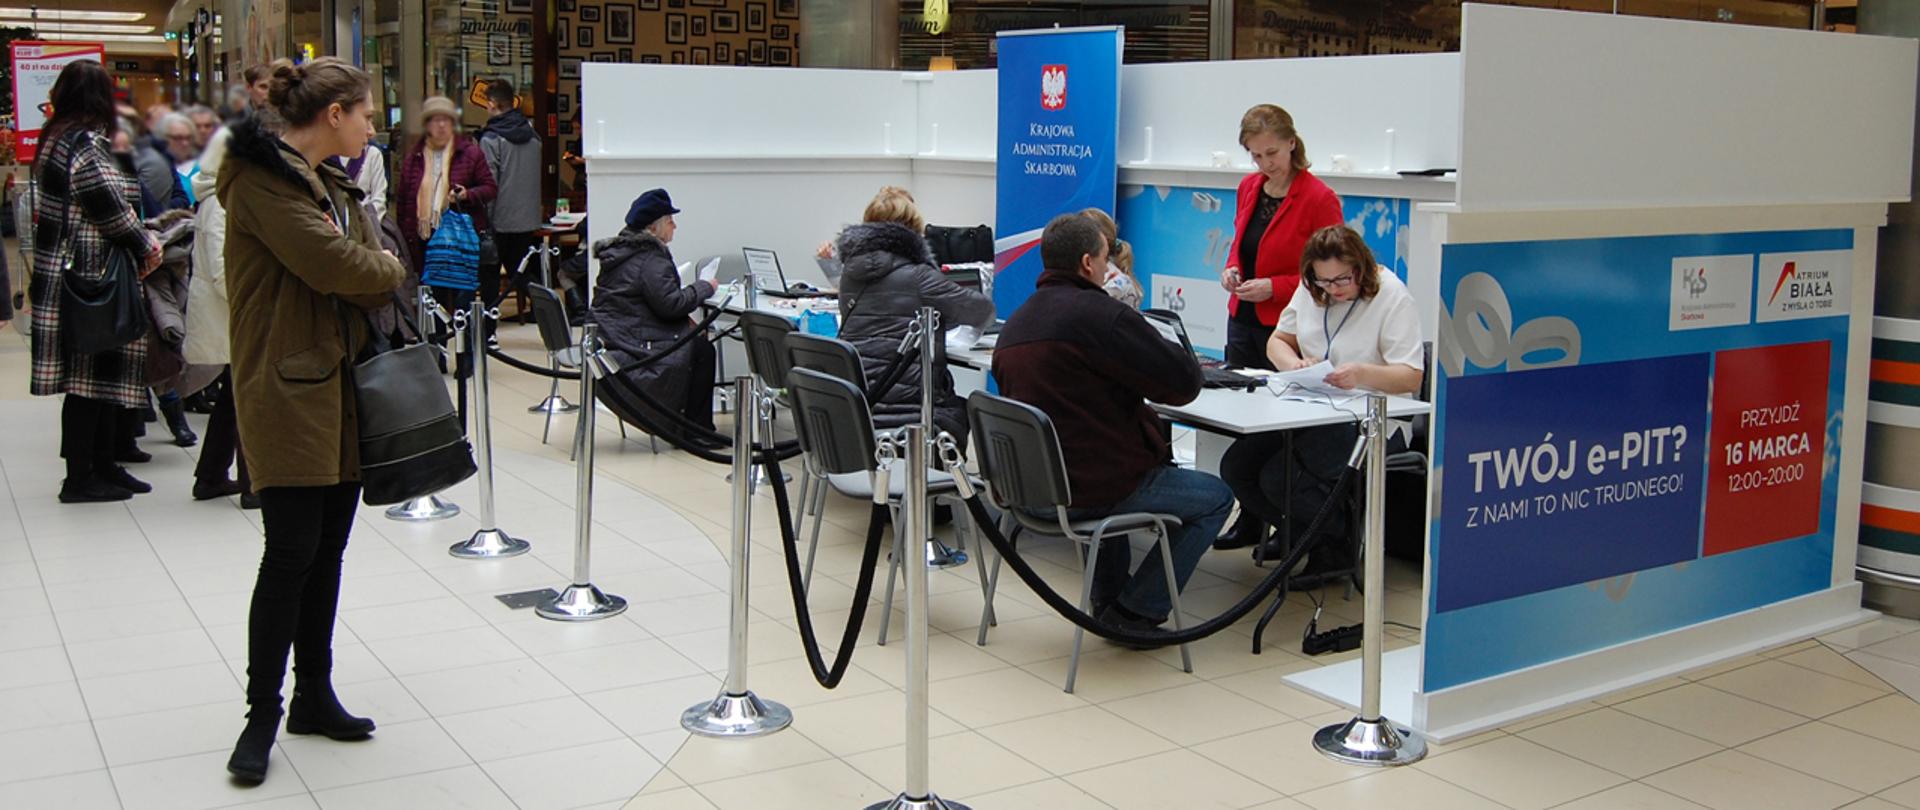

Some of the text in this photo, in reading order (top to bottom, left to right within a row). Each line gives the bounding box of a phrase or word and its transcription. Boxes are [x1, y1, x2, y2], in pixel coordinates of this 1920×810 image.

[1030, 122, 1075, 139] KRAJOWA
[1012, 143, 1093, 158] ADMINISTRACJA
[1024, 161, 1077, 177] SKARBOWA
[1790, 281, 1833, 299] BIAŁA
[1740, 400, 1800, 429] PRZYJDŹ
[1468, 425, 1688, 493] TWÓJ e-PIT?
[1725, 432, 1811, 466] 16 MARCA
[1728, 463, 1804, 493] 12:00-20:00
[1466, 473, 1684, 528] Z NAMI TO NIC TRUDNEGO!
